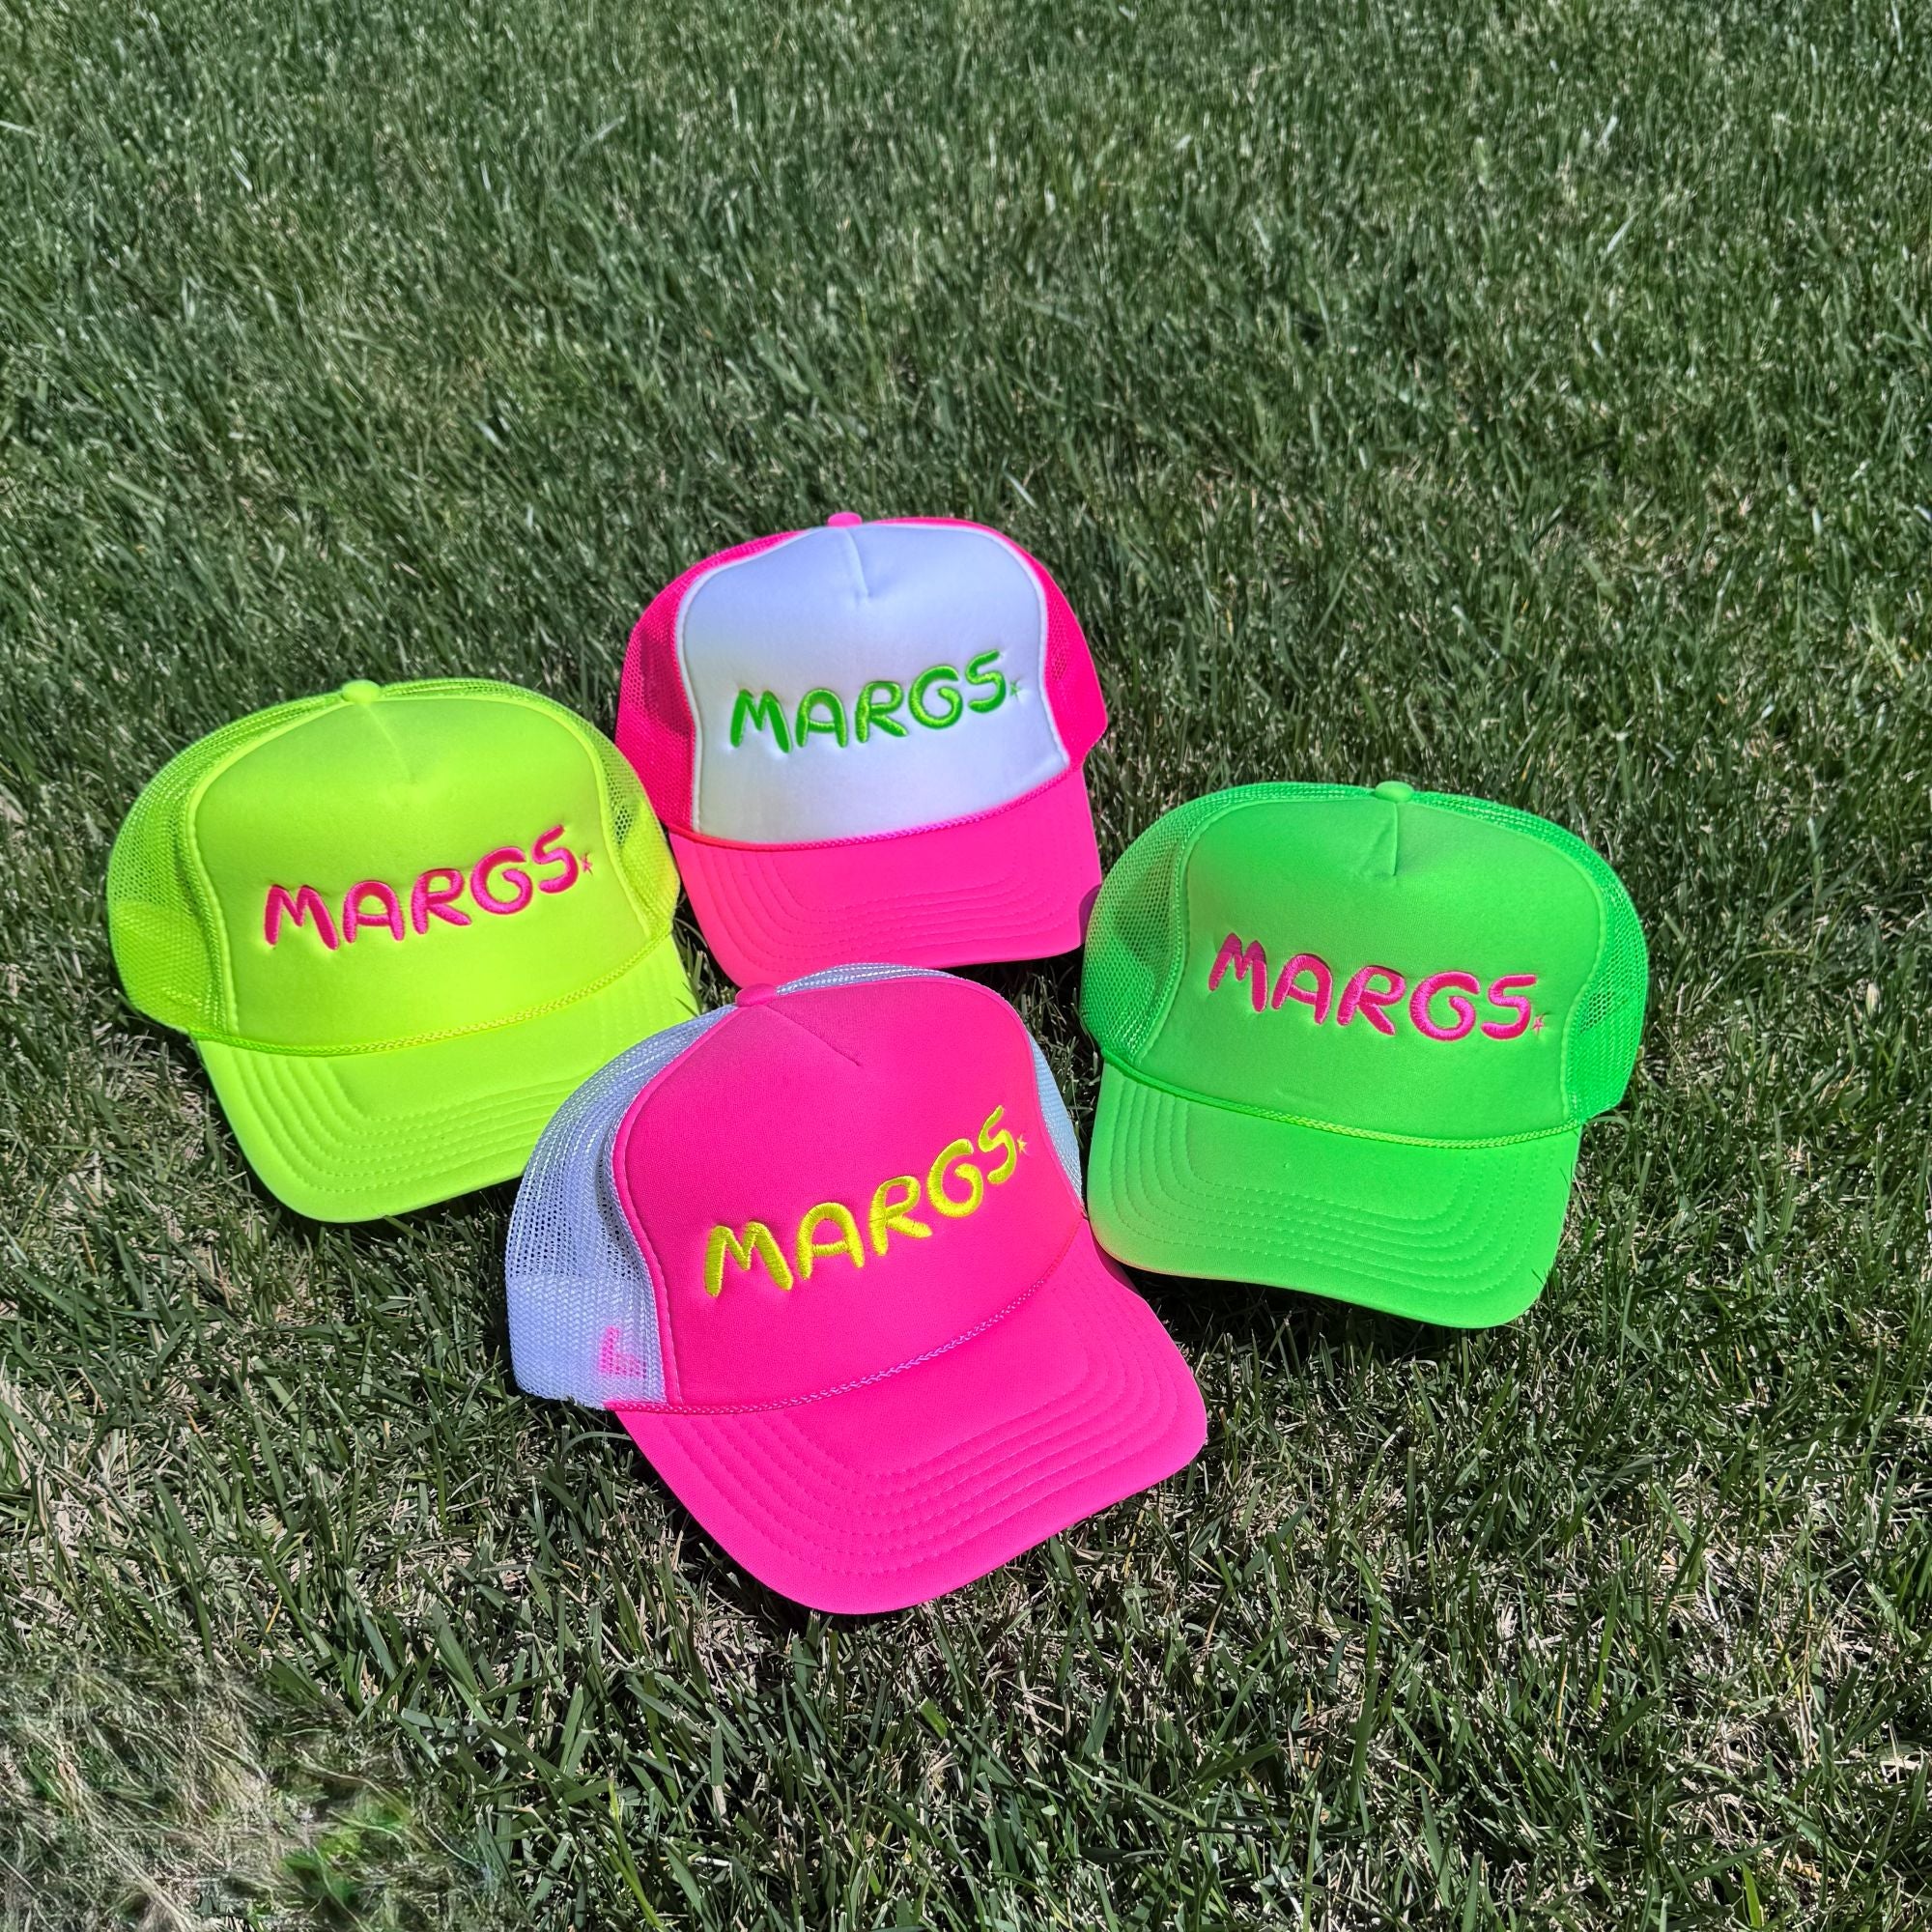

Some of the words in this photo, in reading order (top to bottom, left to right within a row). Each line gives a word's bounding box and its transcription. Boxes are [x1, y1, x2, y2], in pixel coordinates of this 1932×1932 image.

[729, 649, 1007, 753] MARGS
[264, 824, 579, 950] MARGS
[1208, 932, 1537, 1041] MARGS
[704, 1105, 1016, 1296] MARGS
